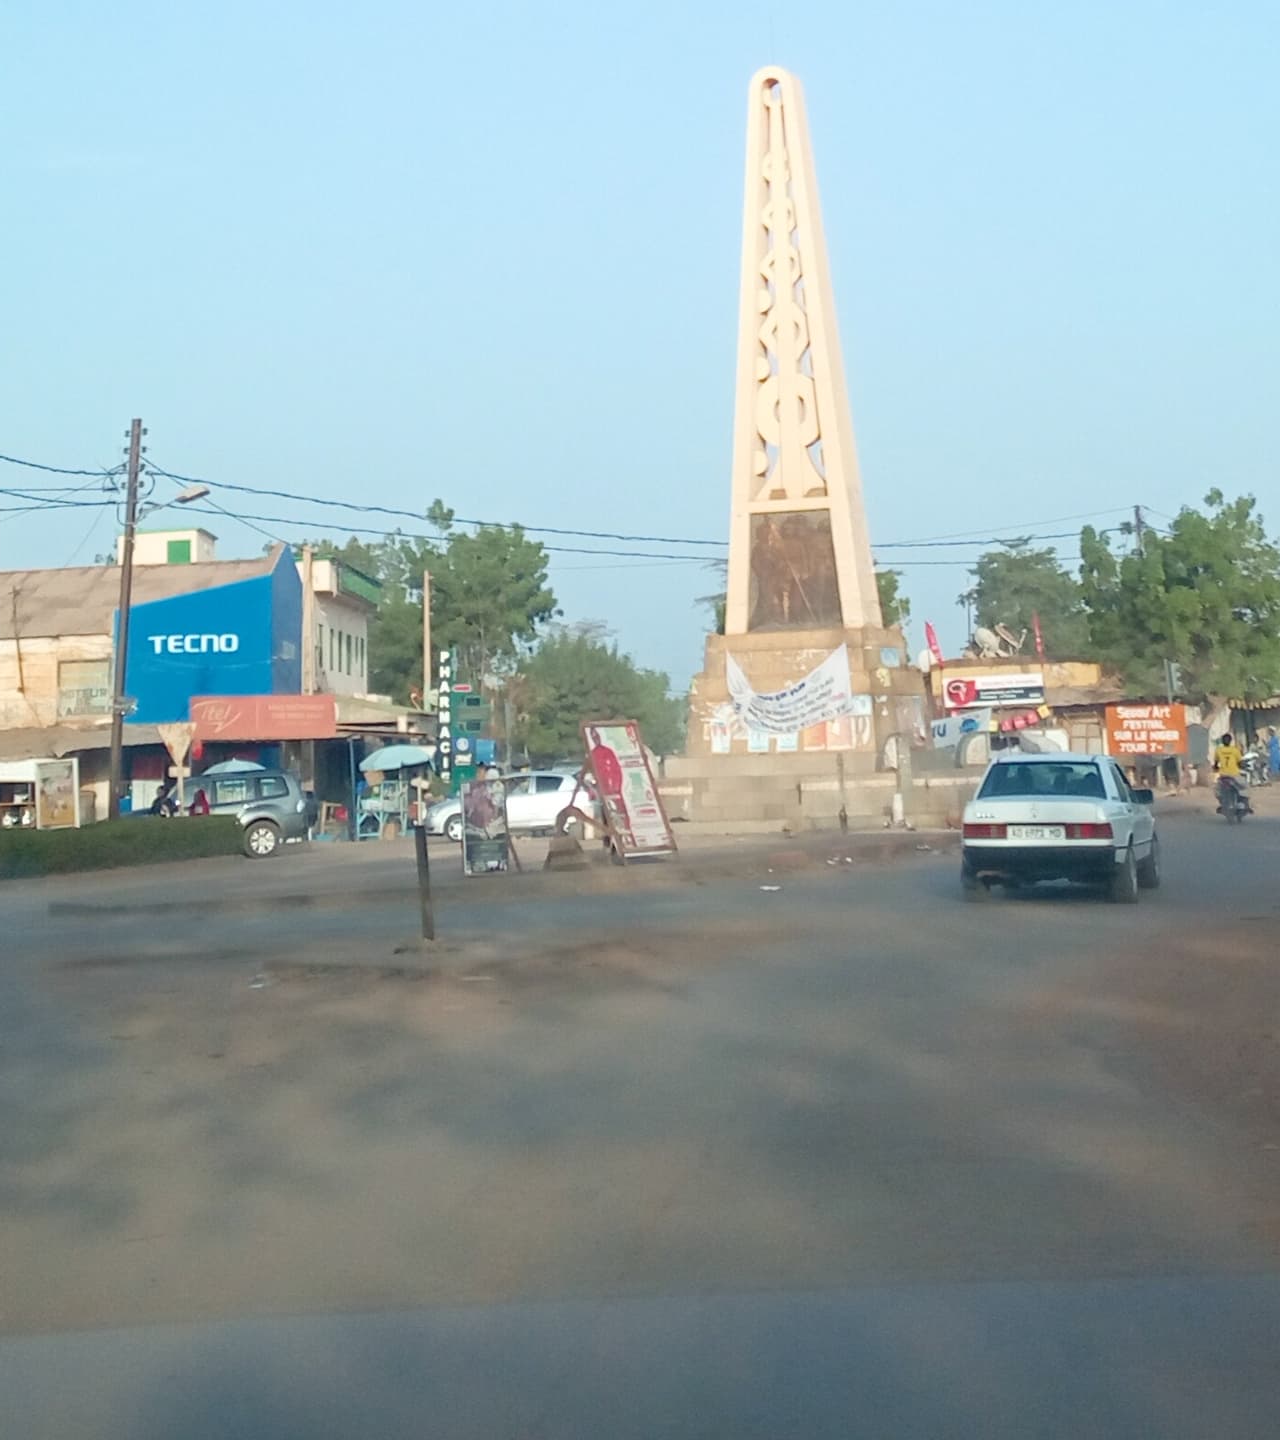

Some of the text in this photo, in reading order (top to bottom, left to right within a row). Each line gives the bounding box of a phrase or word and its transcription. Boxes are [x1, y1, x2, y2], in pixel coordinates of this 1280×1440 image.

[148, 633, 239, 654] TECNO
[439, 651, 451, 783] PHARMACIE
[1113, 730, 1132, 741] SUR
[1134, 730, 1148, 741] LE
